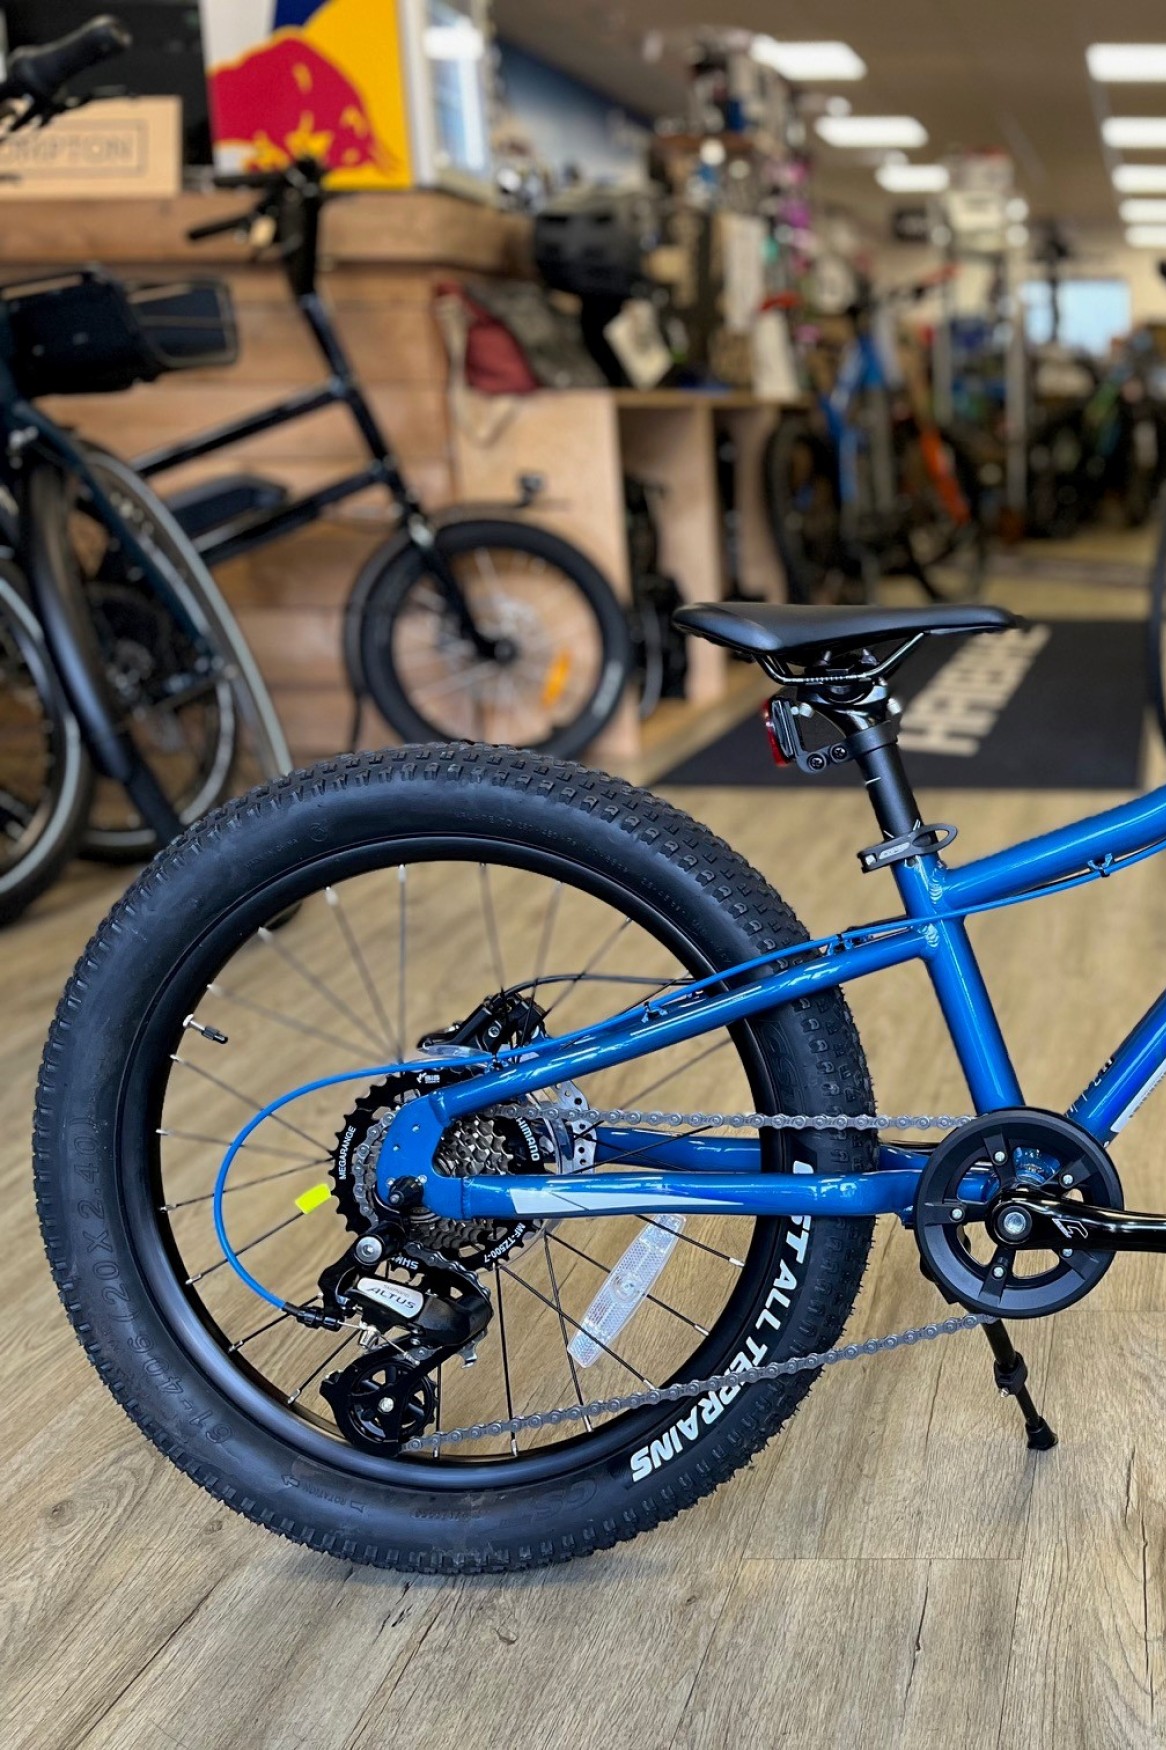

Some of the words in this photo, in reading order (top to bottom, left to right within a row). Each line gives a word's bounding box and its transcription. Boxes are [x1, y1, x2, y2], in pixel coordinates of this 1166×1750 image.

[338, 1125, 356, 1180] MEGARANGE
[515, 1116, 541, 1162] HIMANO
[483, 1222, 526, 1263] MF-TZ500-7
[366, 1286, 416, 1309] ALTUS
[760, 1259, 798, 1330] ALL
